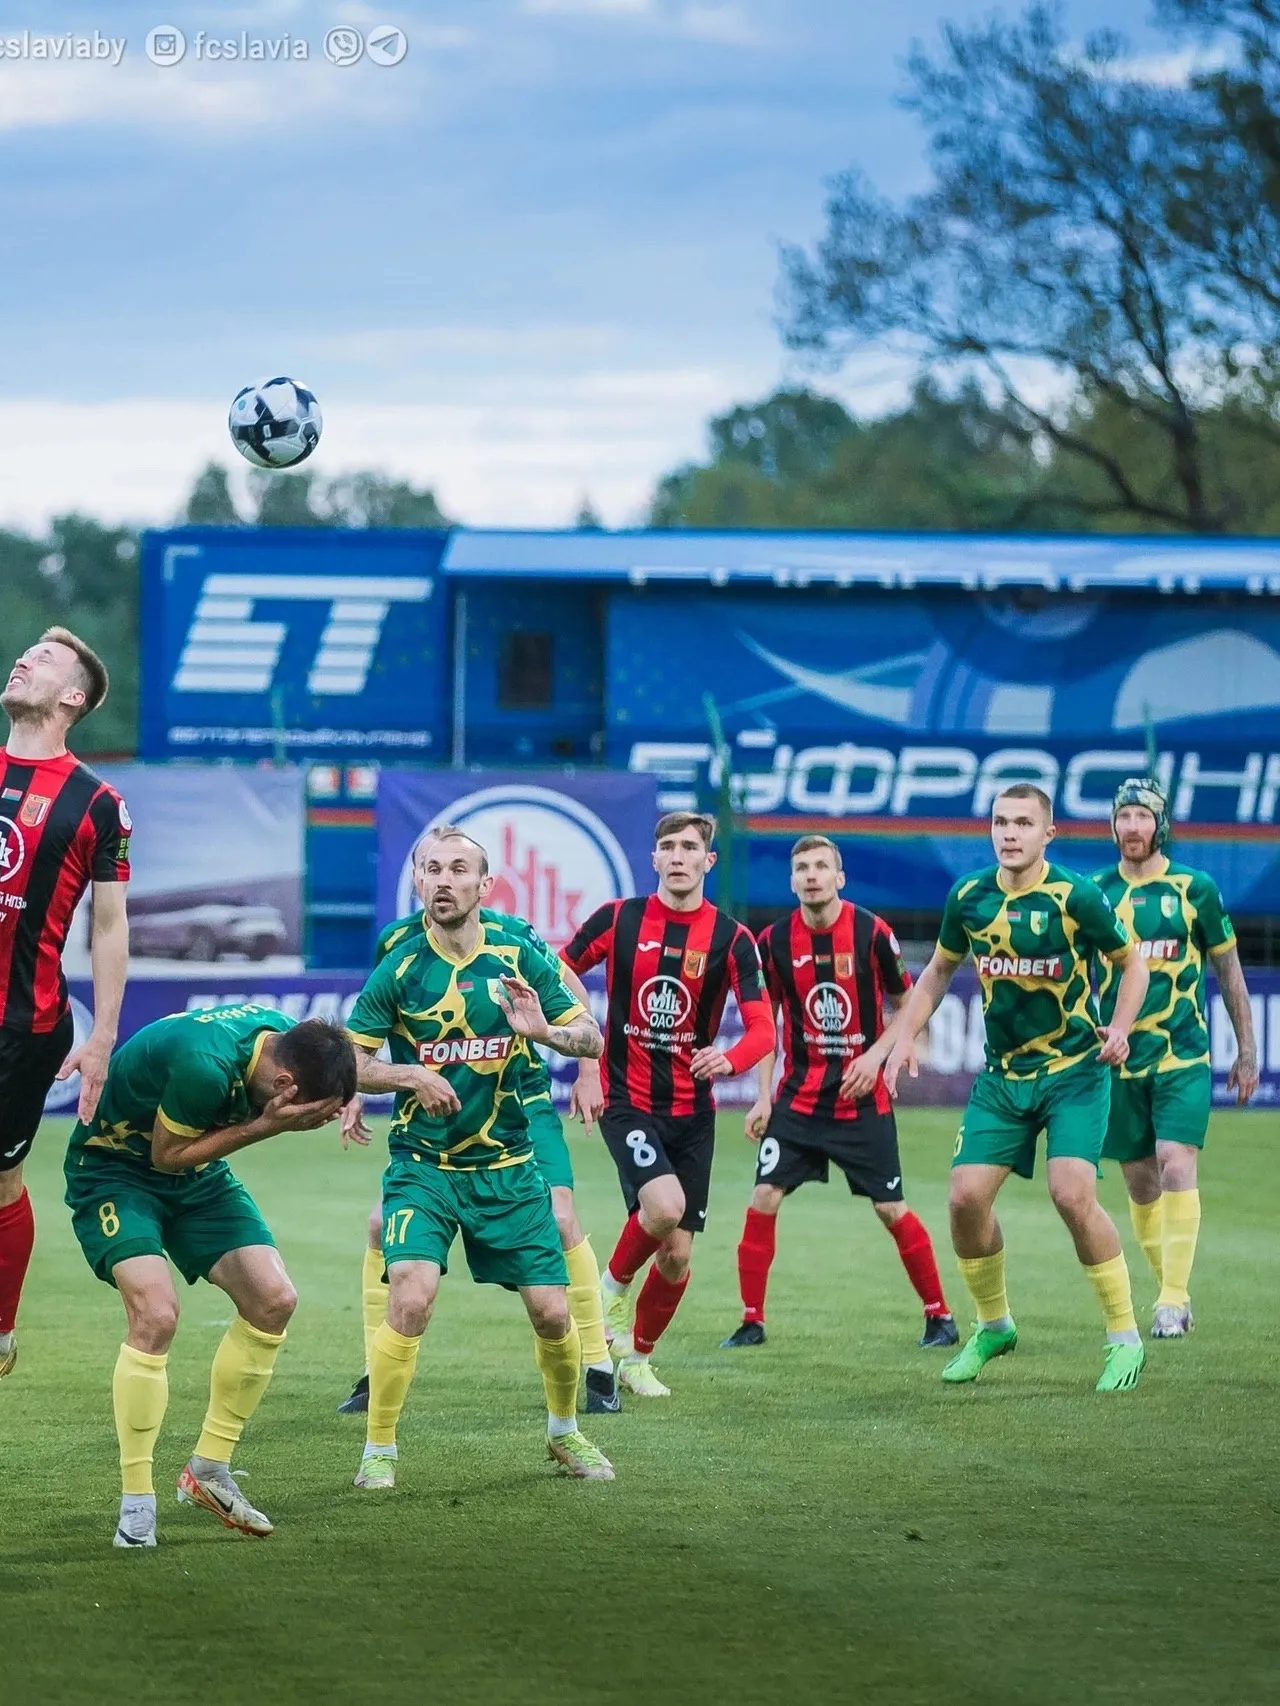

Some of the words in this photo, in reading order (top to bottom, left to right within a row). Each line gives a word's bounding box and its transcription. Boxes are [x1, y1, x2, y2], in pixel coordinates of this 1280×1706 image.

[979, 955, 1060, 977] FONBET
[650, 1012, 675, 1029] ОАО
[419, 1036, 512, 1063] FONBET
[625, 1129, 657, 1169] 8
[759, 1137, 780, 1177] 9
[99, 1201, 120, 1238] 8
[385, 1208, 415, 1247] 47
